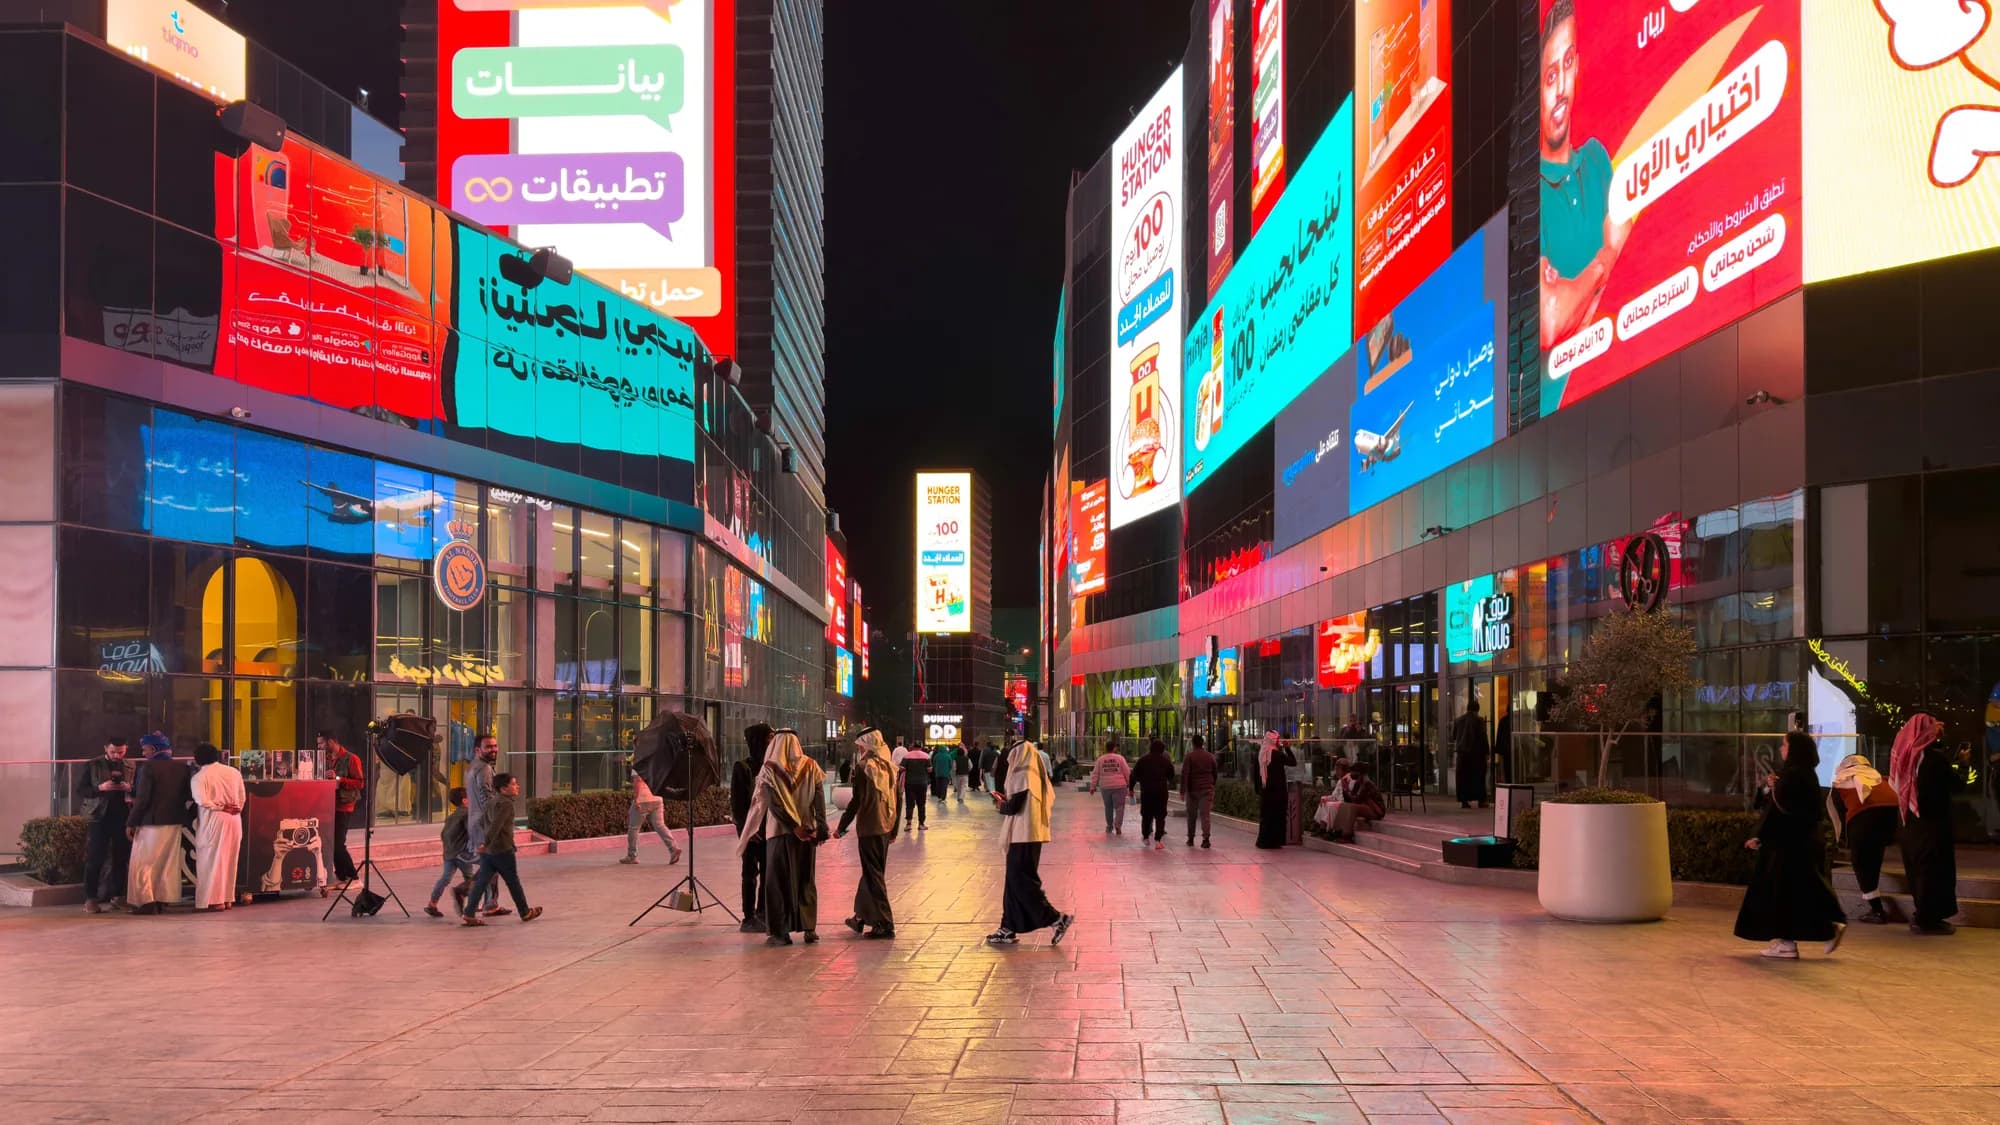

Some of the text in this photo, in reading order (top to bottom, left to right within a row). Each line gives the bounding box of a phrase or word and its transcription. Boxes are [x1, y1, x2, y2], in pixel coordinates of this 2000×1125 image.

[1637, 6, 1666, 48] ريال
[466, 58, 665, 102] بيانات
[1121, 105, 1172, 181] HUNGER
[1626, 65, 1761, 202] اختياري الأول
[521, 166, 667, 210] تطبيقات
[1121, 133, 1172, 208] STATION
[1134, 199, 1164, 259] 100
[1299, 170, 1342, 265] نينجا
[1687, 177, 1786, 257] تطبق الشروط والأحكام
[1710, 226, 1775, 283] شحن مجاني
[651, 279, 705, 307] حمل
[1260, 242, 1296, 320] يجيب
[1324, 253, 1341, 307] كل
[1623, 275, 1690, 332] استرجاع مجاني
[1230, 317, 1255, 387] 100
[1594, 326, 1605, 344] 10
[1463, 340, 1494, 378] وصيل
[927, 485, 961, 495] HUNGER
[927, 495, 961, 505] STATION
[936, 520, 959, 537] 100
[1485, 592, 1510, 622] نوق
[1485, 622, 1510, 652] NOUG
[1111, 676, 1158, 700] MACHINIST
[923, 714, 964, 724] DUNKIN'
[929, 724, 957, 739] DD
